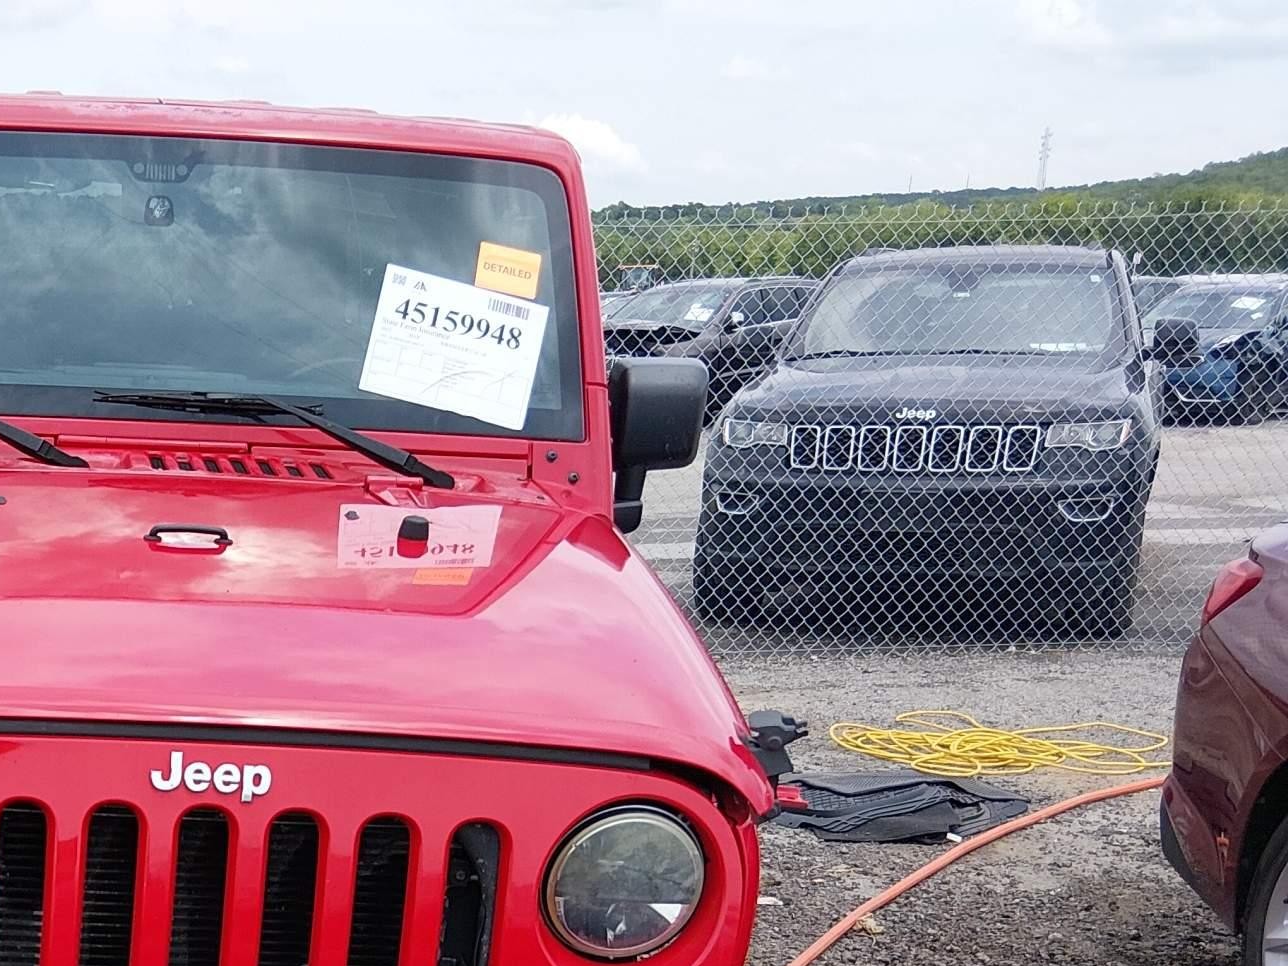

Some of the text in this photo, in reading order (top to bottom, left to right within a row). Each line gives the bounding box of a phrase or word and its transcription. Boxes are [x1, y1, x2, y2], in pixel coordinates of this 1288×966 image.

[482, 261, 532, 281] DETAILED
[395, 298, 523, 350] 45159948
[895, 407, 937, 421] Jeep
[150, 750, 272, 802] Jeep
